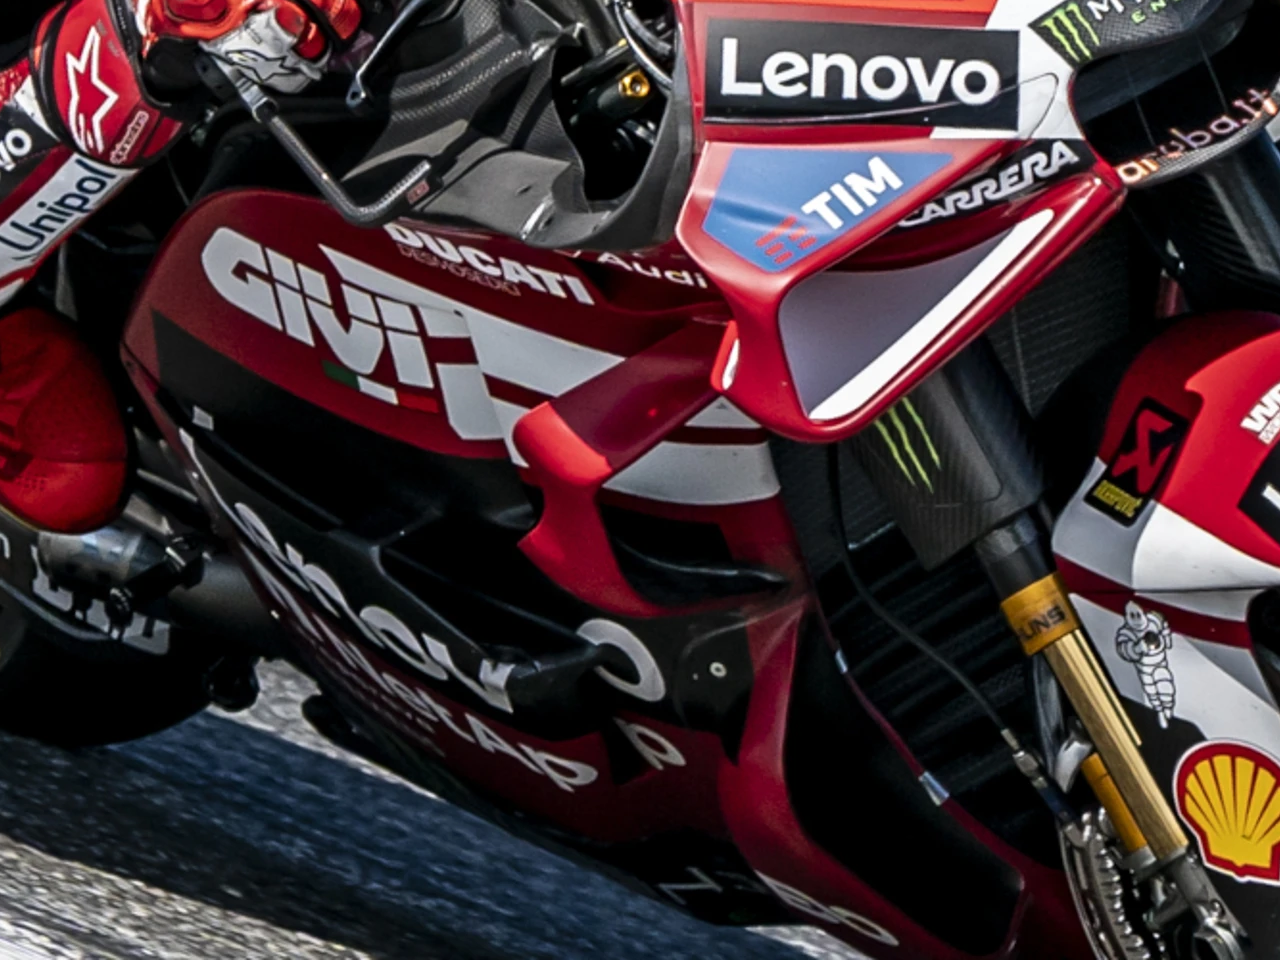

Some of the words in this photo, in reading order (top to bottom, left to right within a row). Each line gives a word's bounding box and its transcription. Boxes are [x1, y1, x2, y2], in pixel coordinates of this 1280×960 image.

[721, 38, 1002, 106] Lenovo
[802, 156, 904, 231] TIM
[898, 140, 1081, 228] CARRERA
[383, 222, 596, 306] DUCATI
[596, 250, 709, 290] Audi
